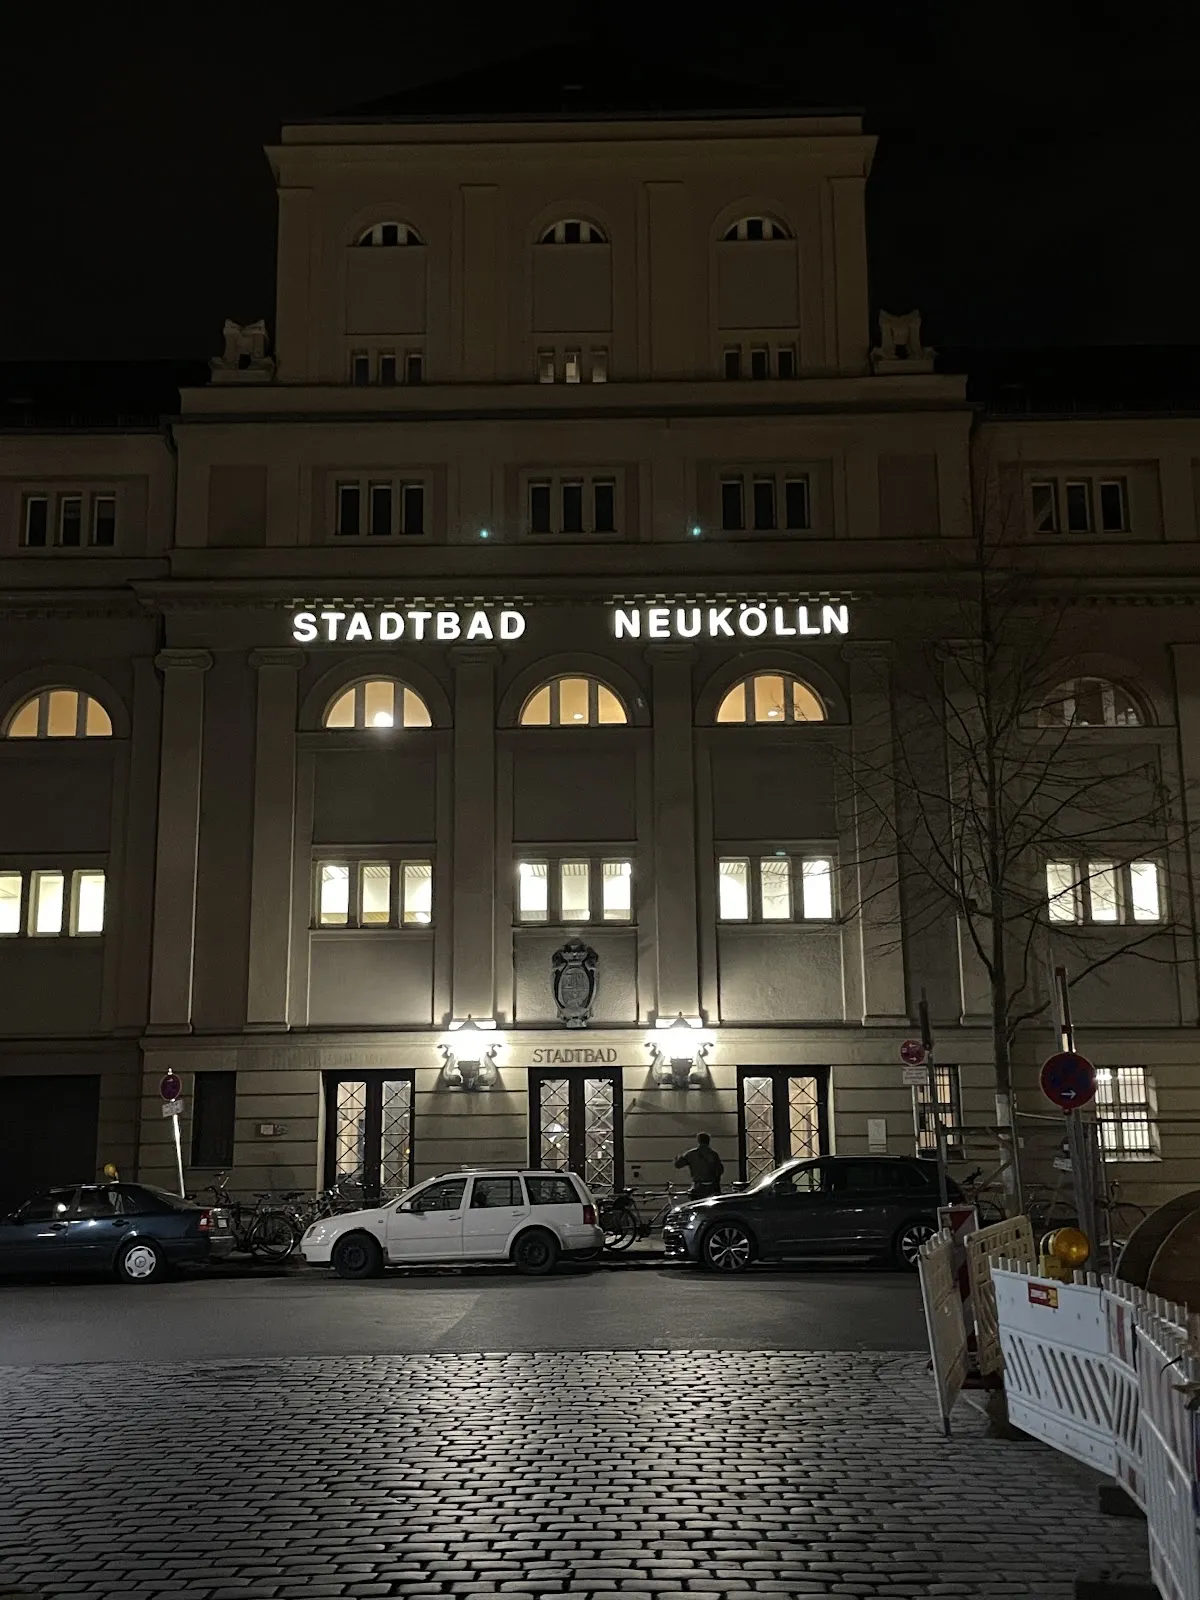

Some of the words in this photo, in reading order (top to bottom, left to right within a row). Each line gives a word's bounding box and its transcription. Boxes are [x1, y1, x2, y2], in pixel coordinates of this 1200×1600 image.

[292, 610, 526, 642] STADTBAD
[614, 602, 849, 639] NEUKÖLLN
[532, 1048, 618, 1063] STADTBAD
